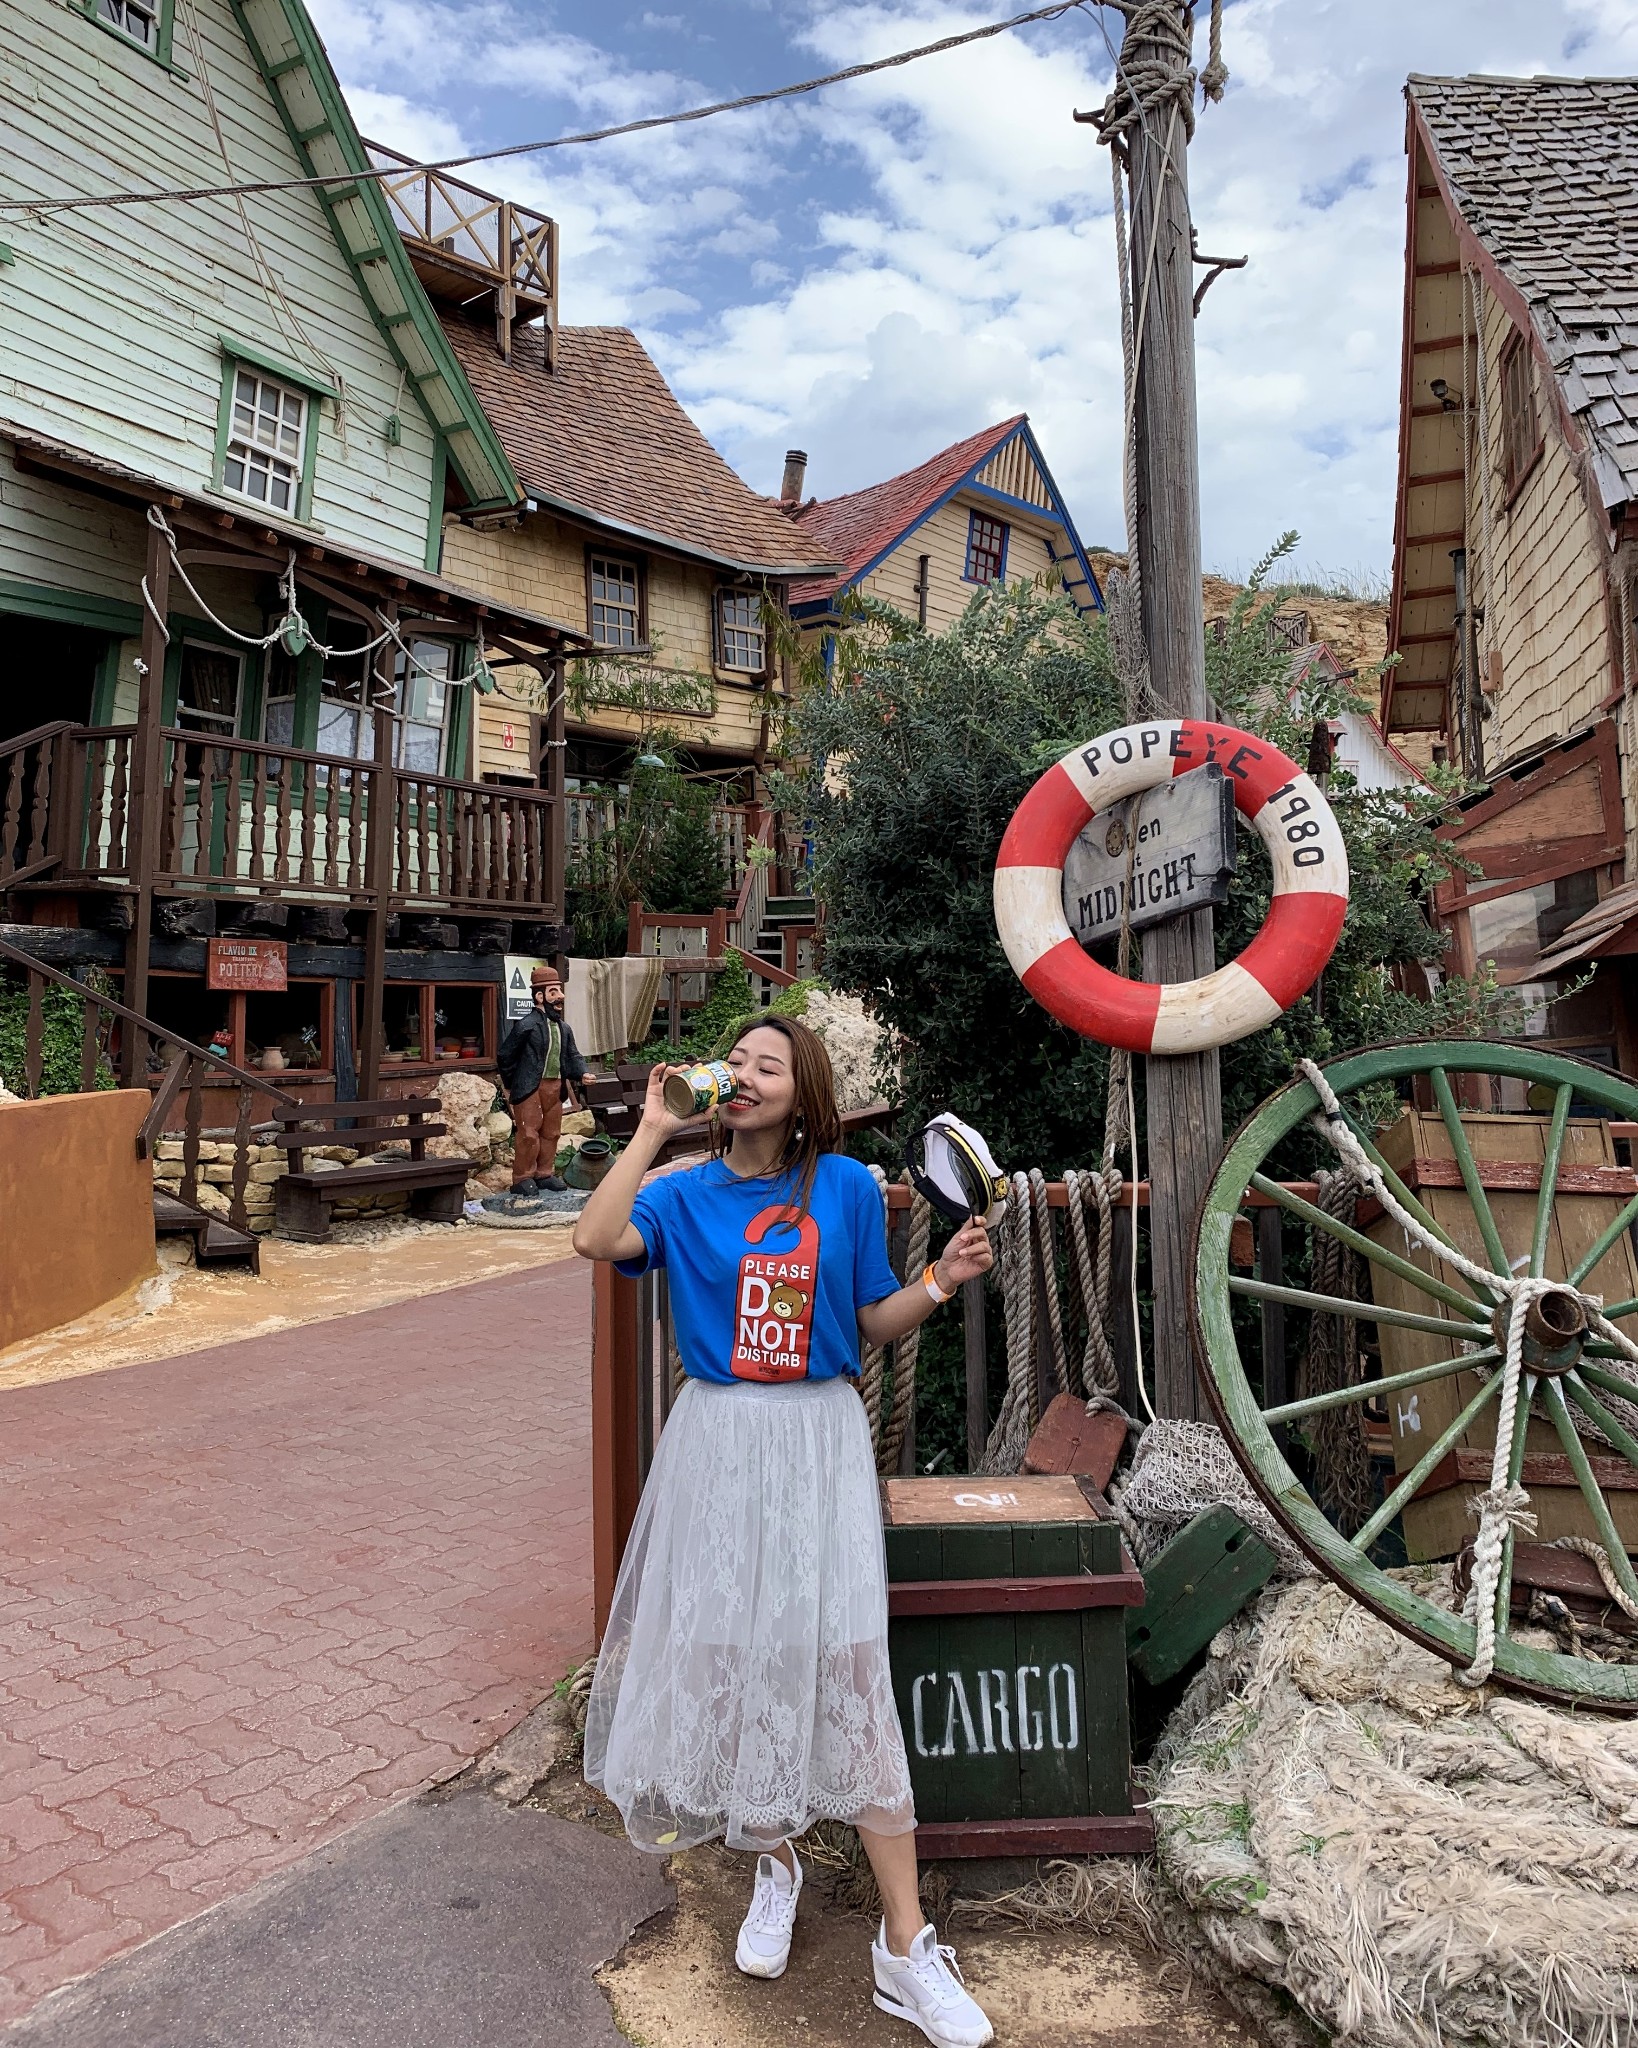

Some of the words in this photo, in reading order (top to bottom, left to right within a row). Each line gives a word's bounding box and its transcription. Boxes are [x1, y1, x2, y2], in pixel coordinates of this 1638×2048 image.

[1081, 729, 1263, 780] POPEYE
[1267, 783, 1325, 868] 1980
[1106, 818, 1161, 857] en
[1077, 852, 1196, 931] MIDNIGHT
[218, 945, 246, 956] FLAVIO
[219, 962, 263, 978] POTTERY
[744, 1259, 811, 1280] PLEASE
[739, 1317, 803, 1352] NOT
[737, 1345, 801, 1368] DISTURB
[912, 1662, 1079, 1757] CARGO
